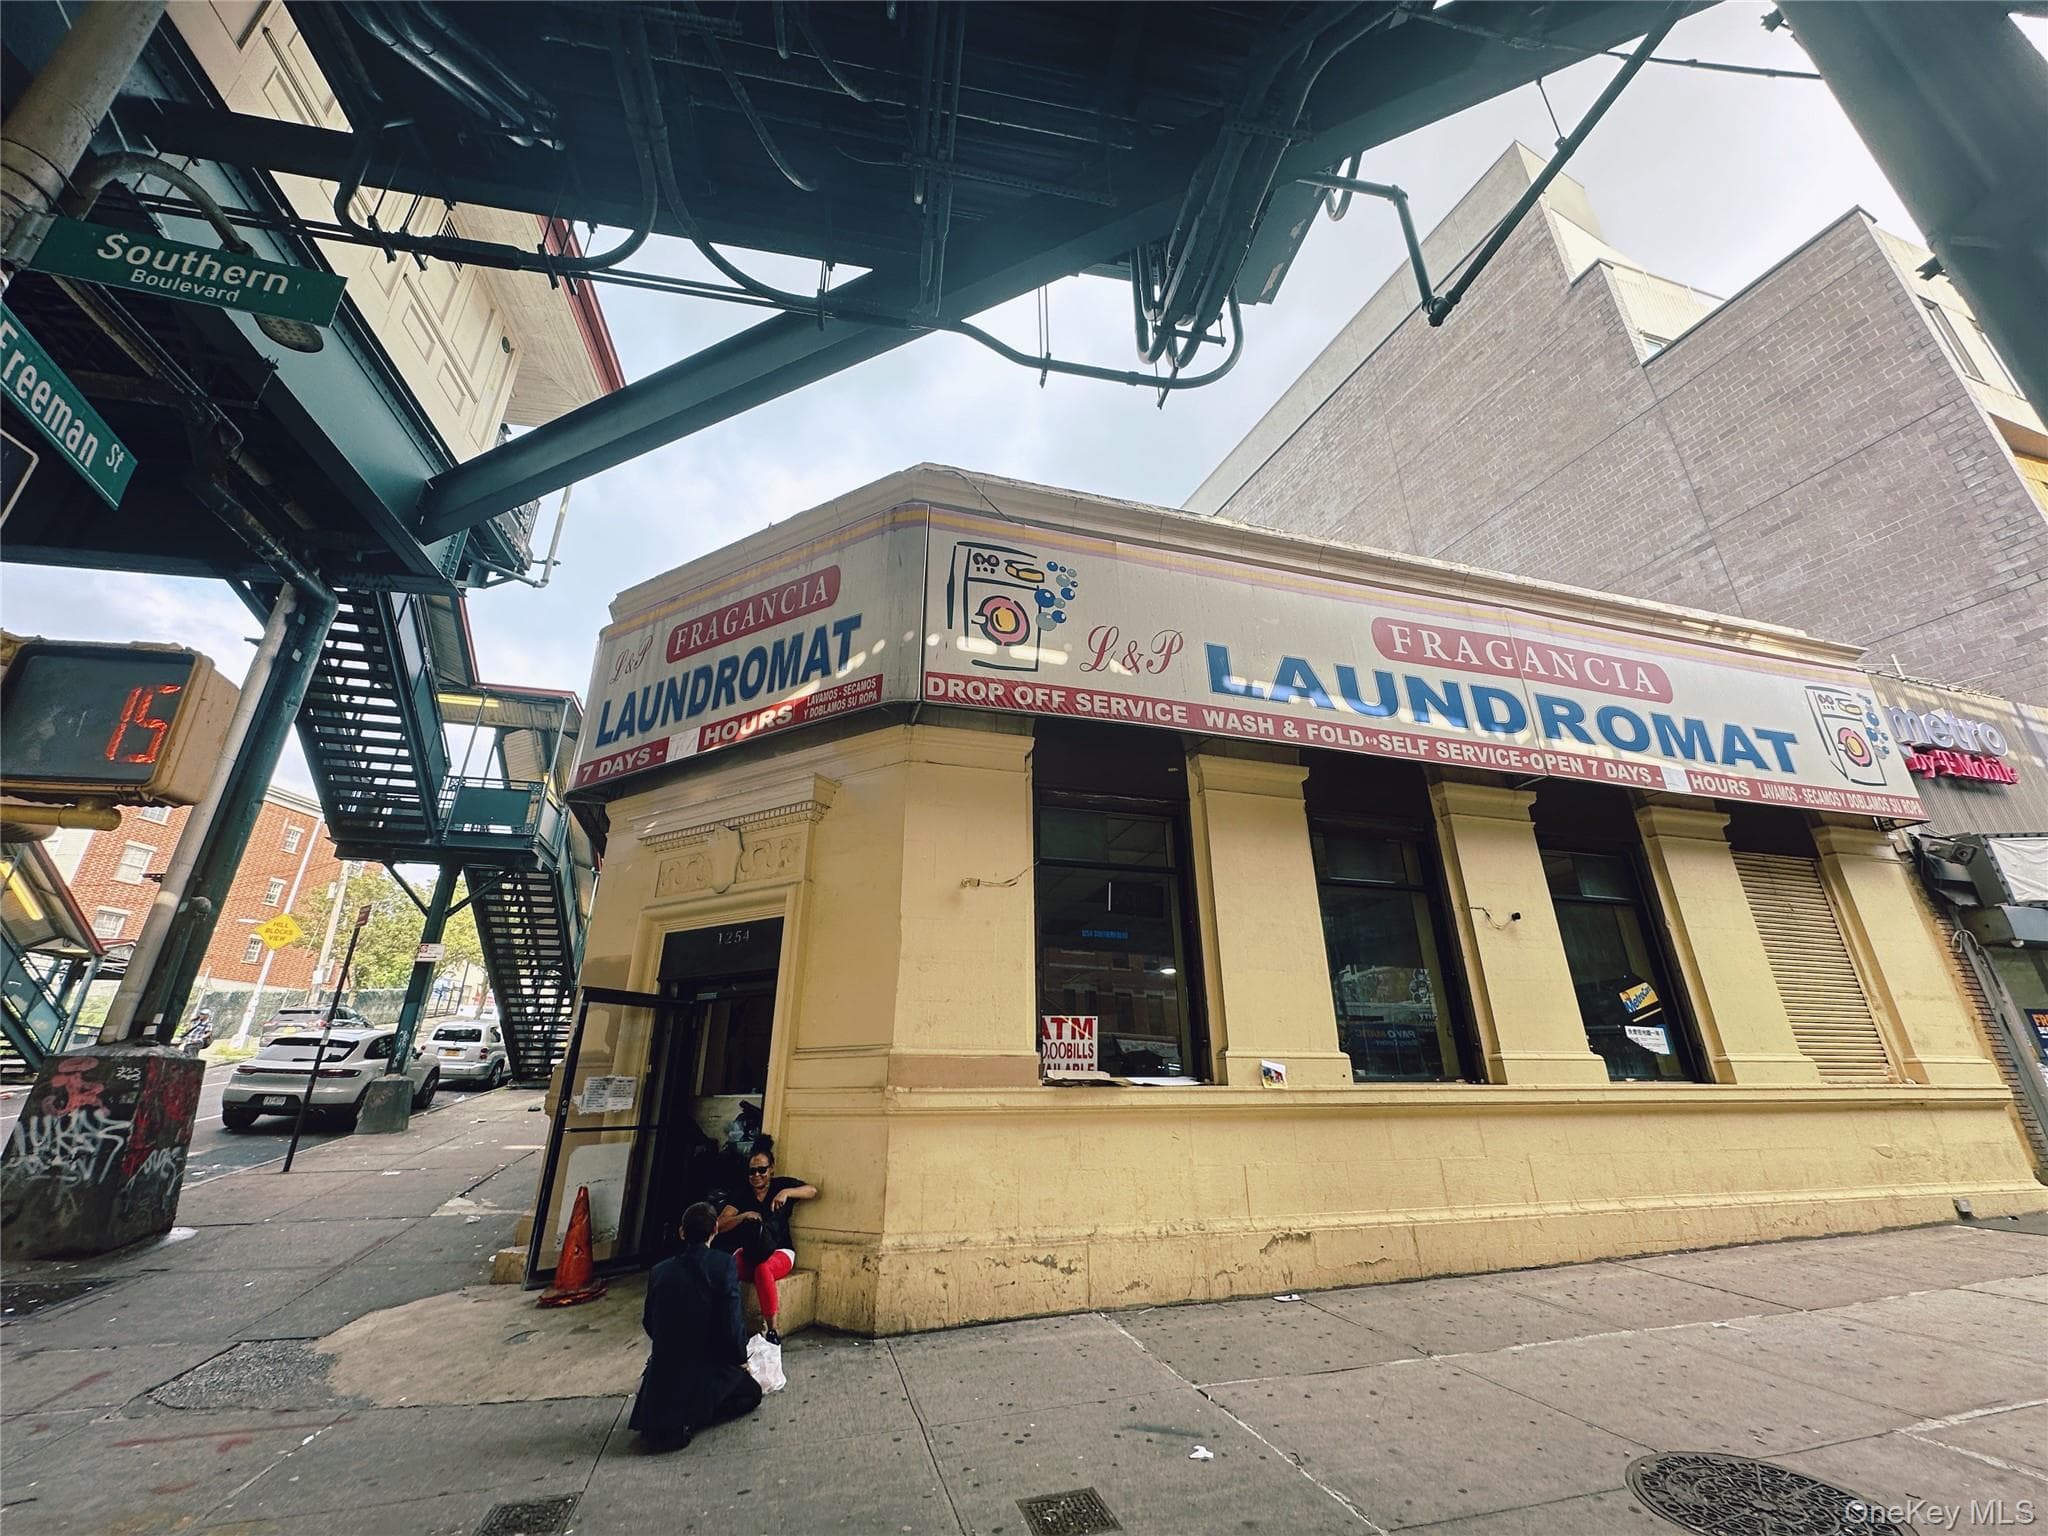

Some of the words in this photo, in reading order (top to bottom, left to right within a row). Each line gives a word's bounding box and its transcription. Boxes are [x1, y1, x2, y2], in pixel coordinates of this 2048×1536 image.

[96, 233, 289, 295] Southern
[130, 268, 240, 303] Boulevard
[0, 320, 100, 468] Freeman
[106, 444, 124, 474] St
[673, 574, 828, 656] FRAGANCIA
[609, 634, 654, 685] L&P
[1079, 625, 1185, 675] L&P
[1387, 623, 1660, 696] FRAGANCIA
[595, 612, 862, 748] LAUNDROMAT
[807, 688, 838, 707] LAVAMOS
[843, 678, 876, 697] SECAMOS
[809, 701, 846, 719] DOBLAMOS
[847, 696, 857, 708] SU
[859, 690, 877, 705] ROPA
[1204, 641, 1800, 775] LAUNDROMAT
[105, 684, 182, 763] 15
[583, 764, 595, 783] 7
[598, 747, 651, 778] DAYS
[703, 703, 794, 747] HOURS
[927, 676, 1006, 702] DROP
[1014, 685, 1066, 711] OFF
[1075, 694, 1188, 724] SERVICE
[1202, 709, 1275, 738] WASH
[1283, 719, 1300, 739] &
[1588, 759, 1598, 776] 7
[1604, 761, 1651, 784] DAYS
[1689, 773, 1751, 796] HOURS
[1884, 706, 2008, 757] metro
[1757, 782, 1799, 802] LAVAMOS
[1802, 788, 1840, 807] SECAMOS
[1847, 793, 1889, 813] DOBLAMOS
[1890, 799, 1903, 814] SU
[1903, 799, 1923, 816] ROPA
[717, 930, 750, 944] 1254
[1042, 1017, 1093, 1040] ATM
